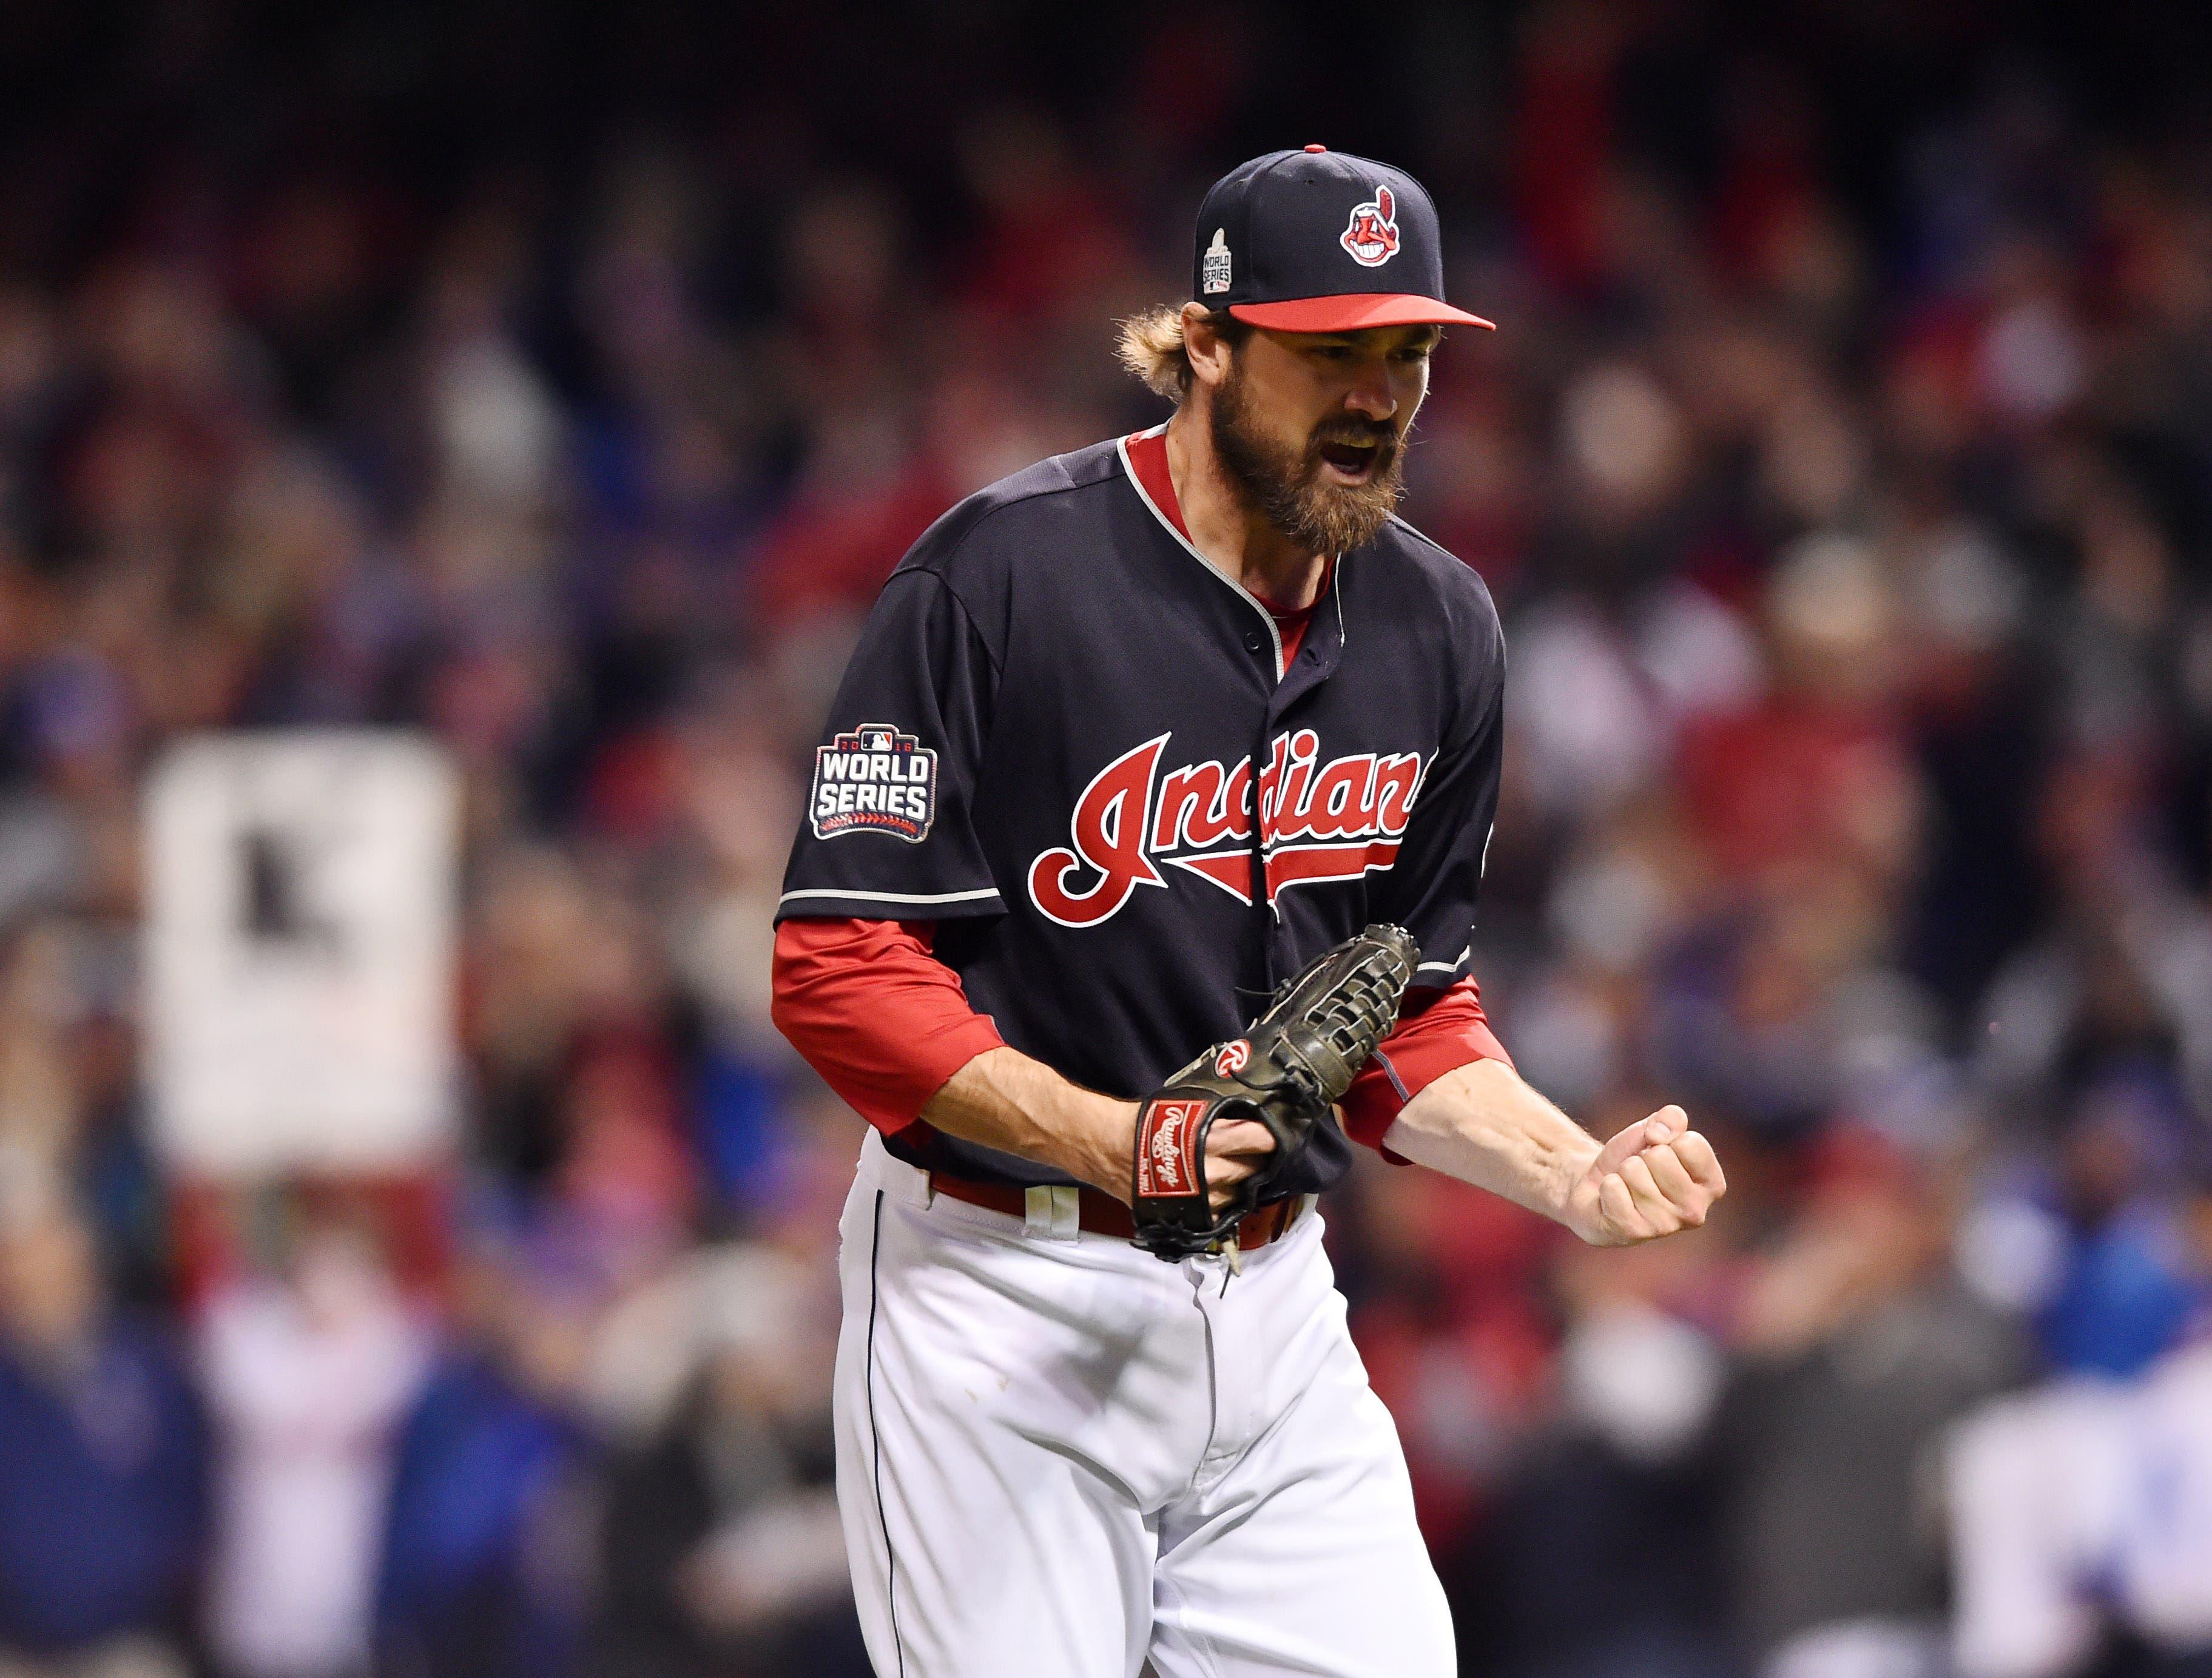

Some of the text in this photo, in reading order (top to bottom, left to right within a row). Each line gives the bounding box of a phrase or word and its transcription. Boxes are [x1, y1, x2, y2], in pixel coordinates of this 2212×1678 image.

[1204, 255, 1229, 268] WORLD
[1204, 268, 1229, 284] SERIES
[841, 741, 912, 752] 20 16
[823, 753, 929, 783] WORLD
[817, 783, 927, 821] SERIES
[1028, 729, 1439, 929] Indian
[1152, 1107, 1184, 1187] Rawlings
